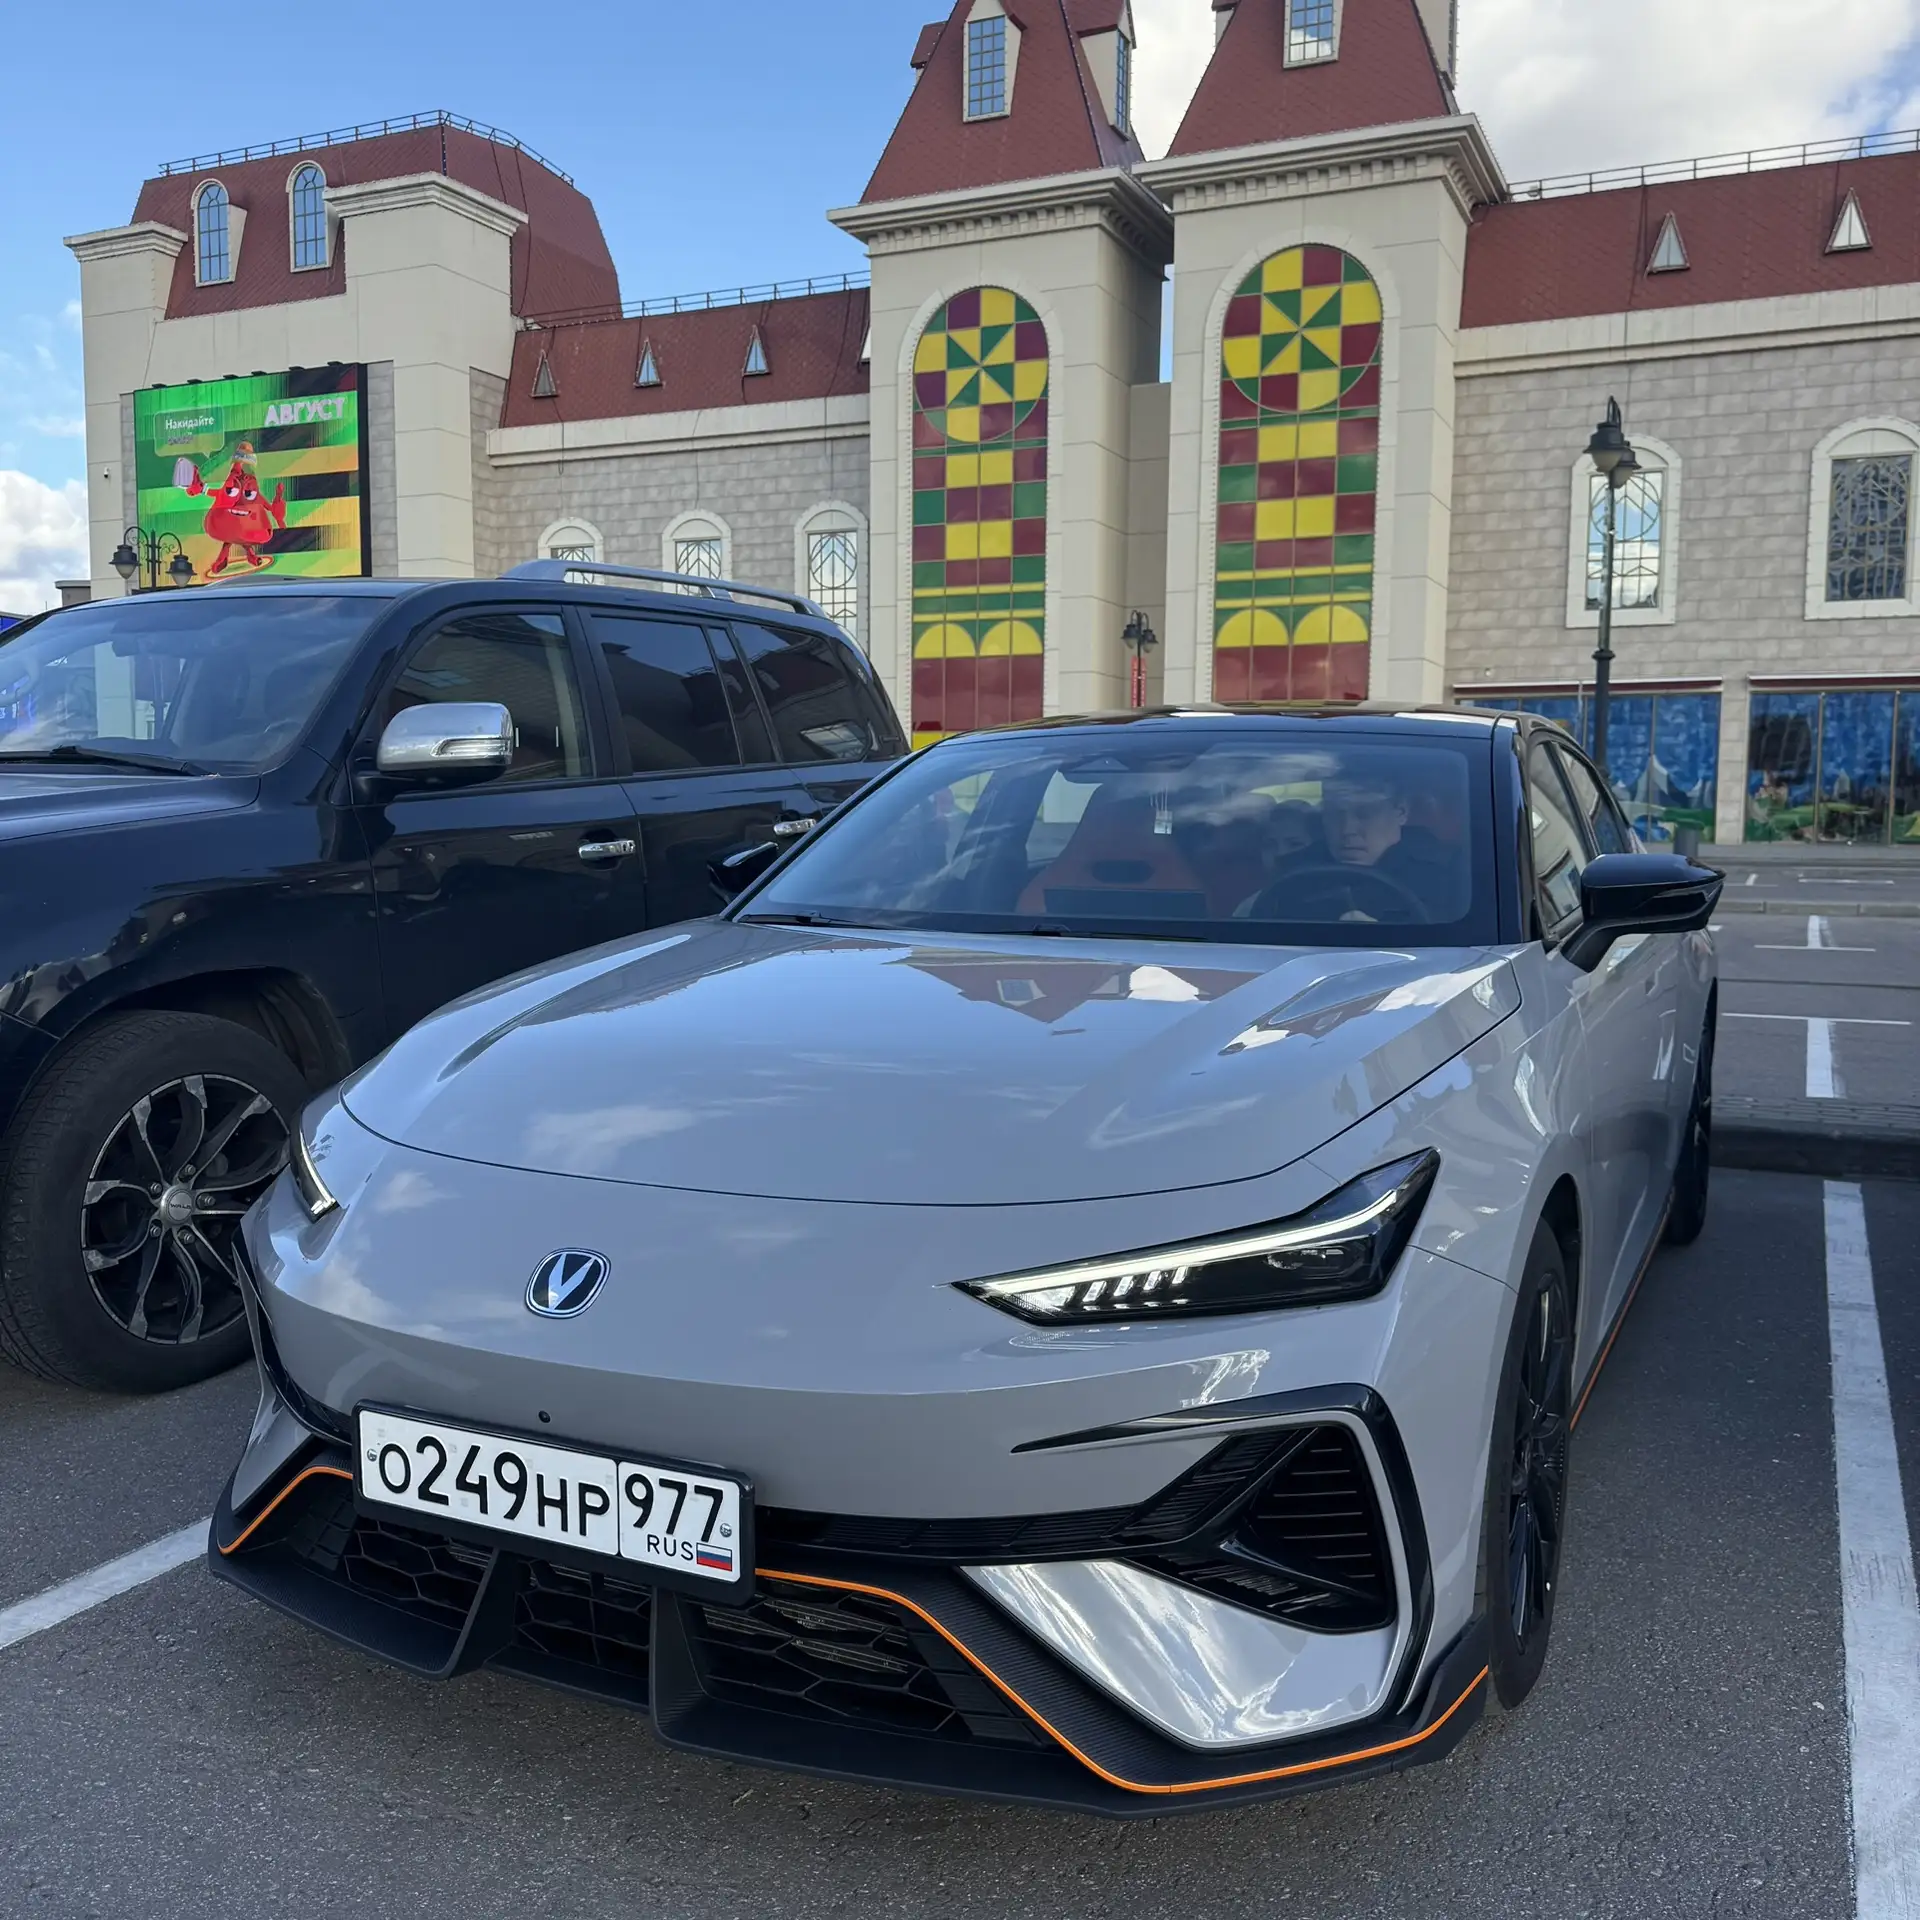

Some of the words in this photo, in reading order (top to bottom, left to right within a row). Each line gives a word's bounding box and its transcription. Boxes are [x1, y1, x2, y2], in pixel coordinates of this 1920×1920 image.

[165, 416, 215, 430] Накидайте
[264, 397, 346, 428] АВГУСТ
[624, 1473, 724, 1543] 977
[647, 1534, 694, 1561] RUS
